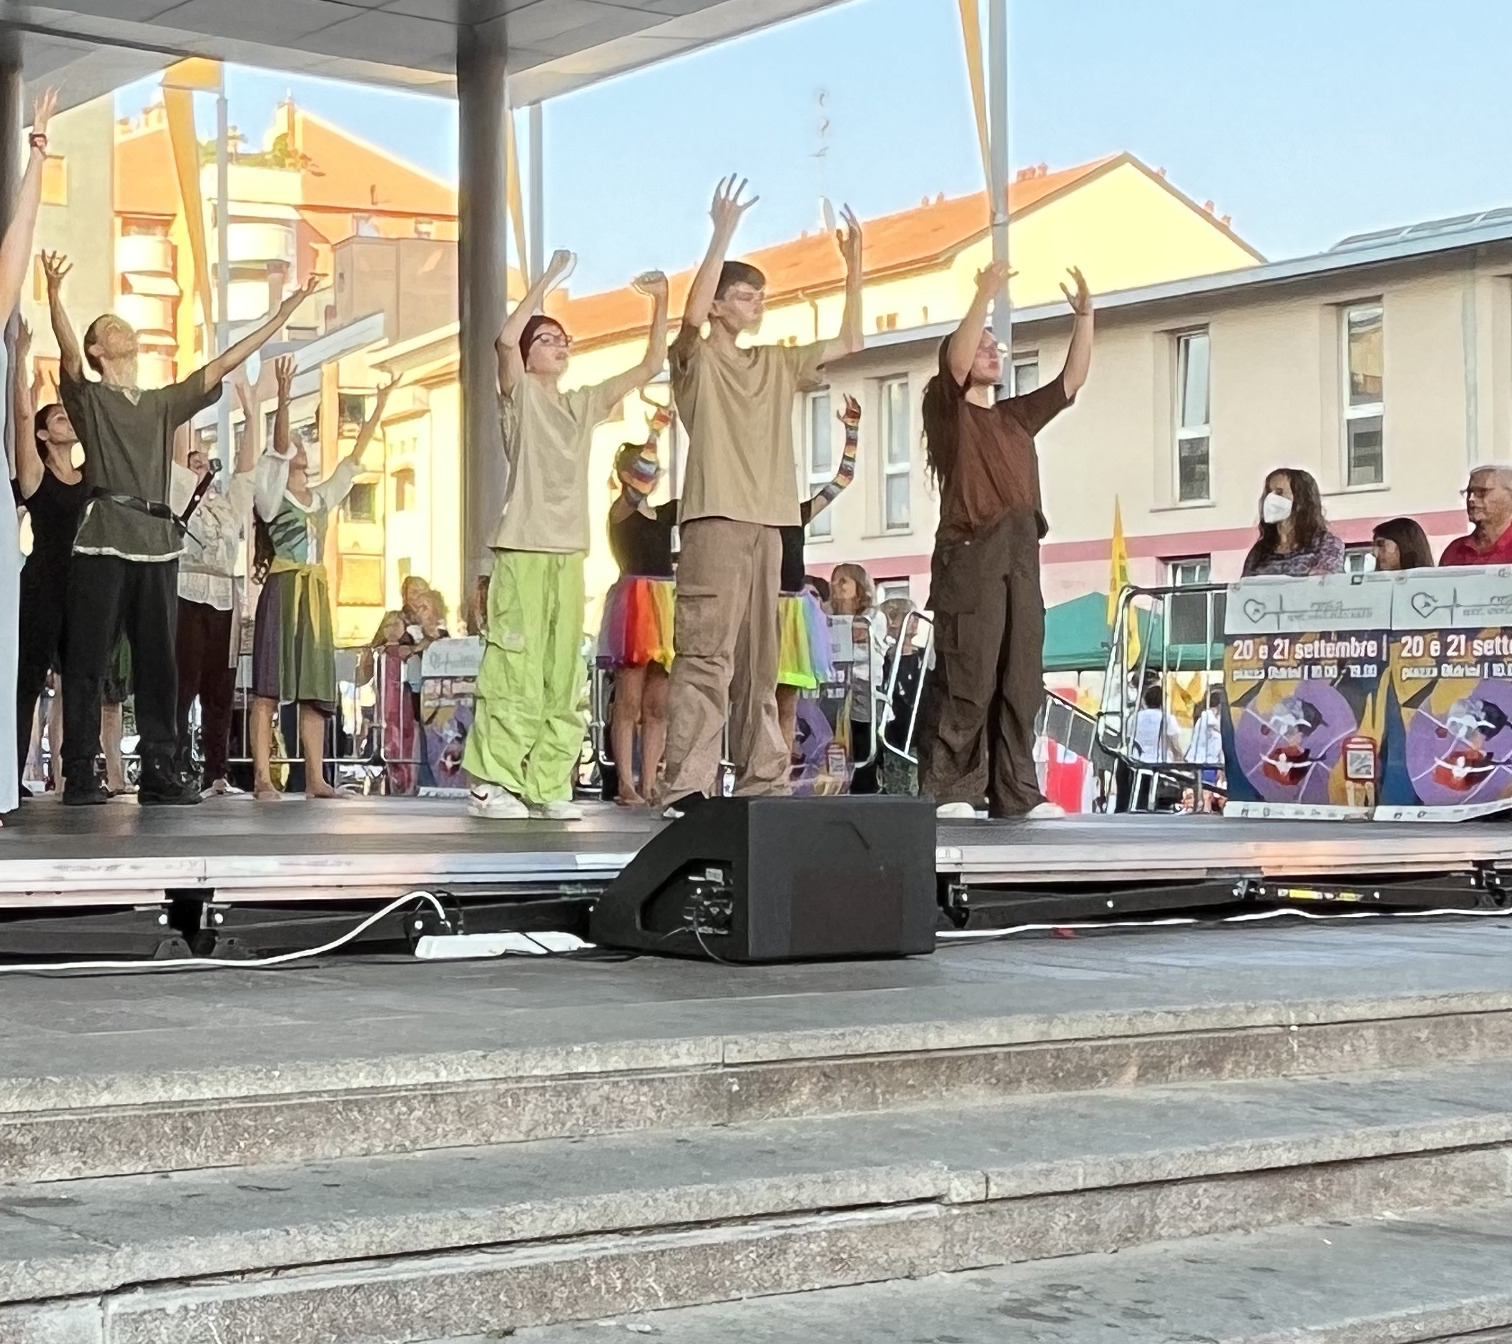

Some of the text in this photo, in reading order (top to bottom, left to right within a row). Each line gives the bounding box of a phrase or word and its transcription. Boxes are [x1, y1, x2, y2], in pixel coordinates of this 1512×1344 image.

[1233, 636, 1378, 660] 20 e 21 settembre
[1400, 635, 1424, 657] 20
[1430, 640, 1441, 657] e
[1446, 634, 1466, 656] 21
